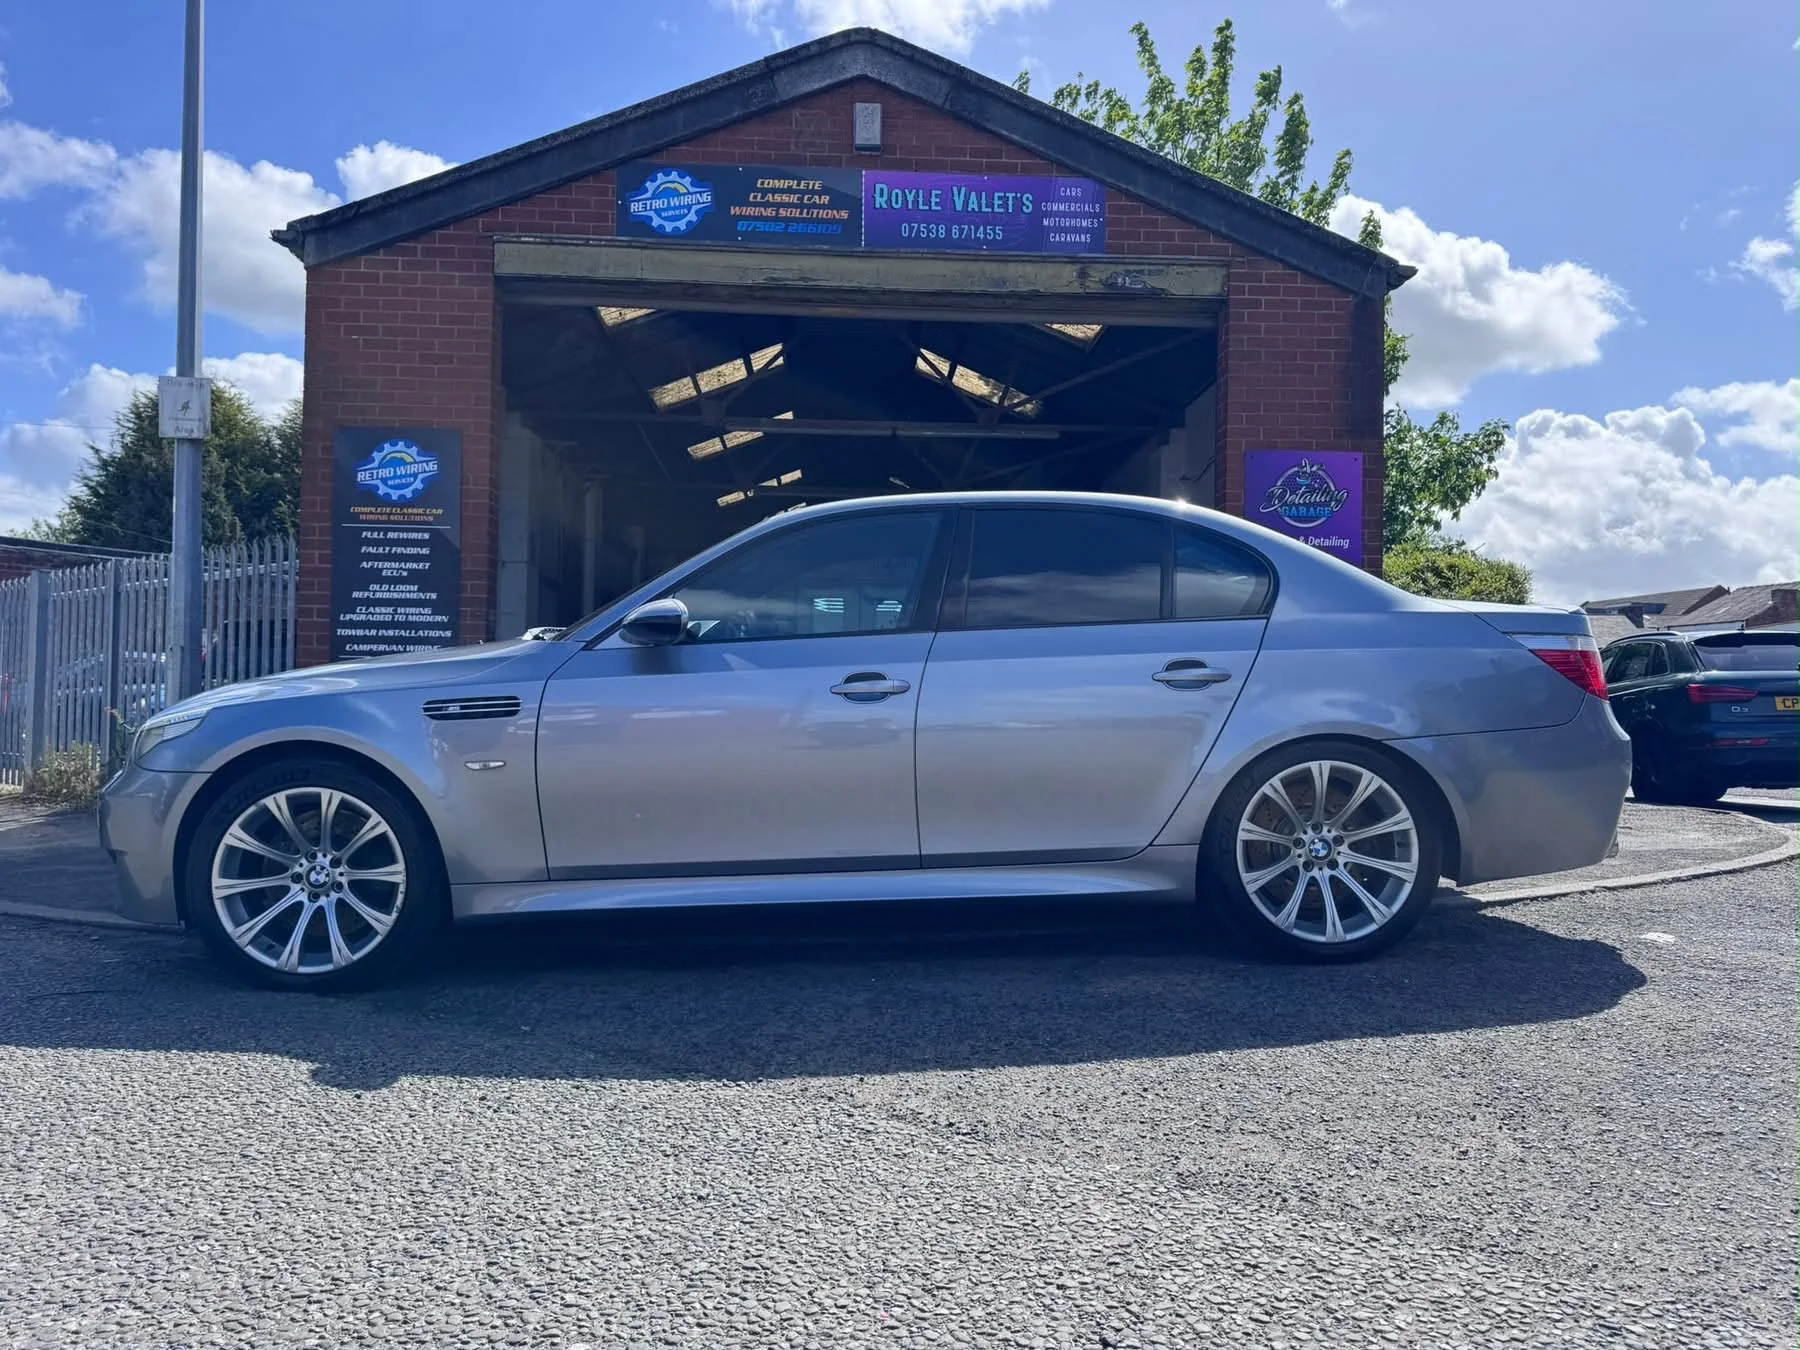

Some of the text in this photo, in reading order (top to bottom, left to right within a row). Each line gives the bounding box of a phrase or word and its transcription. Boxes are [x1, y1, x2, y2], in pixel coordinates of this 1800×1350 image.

[756, 178, 823, 190] COMPLETE
[1060, 187, 1082, 197] CARS
[630, 191, 712, 212] RETRO WIRING
[749, 192, 830, 205] CLASSIC CAR
[874, 183, 1033, 214] ROYLE VALET'S
[730, 206, 849, 220] WIRING SOLUTIONS
[1041, 202, 1101, 213] COMMERCIALS
[736, 220, 786, 232] 07502
[1042, 217, 1099, 228] MOTORHOMES
[901, 223, 1004, 240] 07538 671455
[1049, 232, 1092, 244] CARAVANS
[357, 460, 438, 482] RETRO WIRING
[1259, 483, 1349, 512] Detailing
[350, 506, 390, 514] COMPLETE
[1281, 506, 1332, 517] GARAGE
[361, 531, 431, 540] FULL REWIRES
[1307, 536, 1350, 549] Detailing
[360, 546, 431, 555] FAULT FINDING
[360, 561, 431, 569] AFTERMARKET
[351, 591, 438, 599] REFURBISHMENTS
[396, 607, 432, 615] WIRING
[340, 613, 393, 621] UPGRADED
[336, 628, 453, 637] TOWBAR INSTALLATIONS
[345, 643, 405, 652] CAMPERVAN
